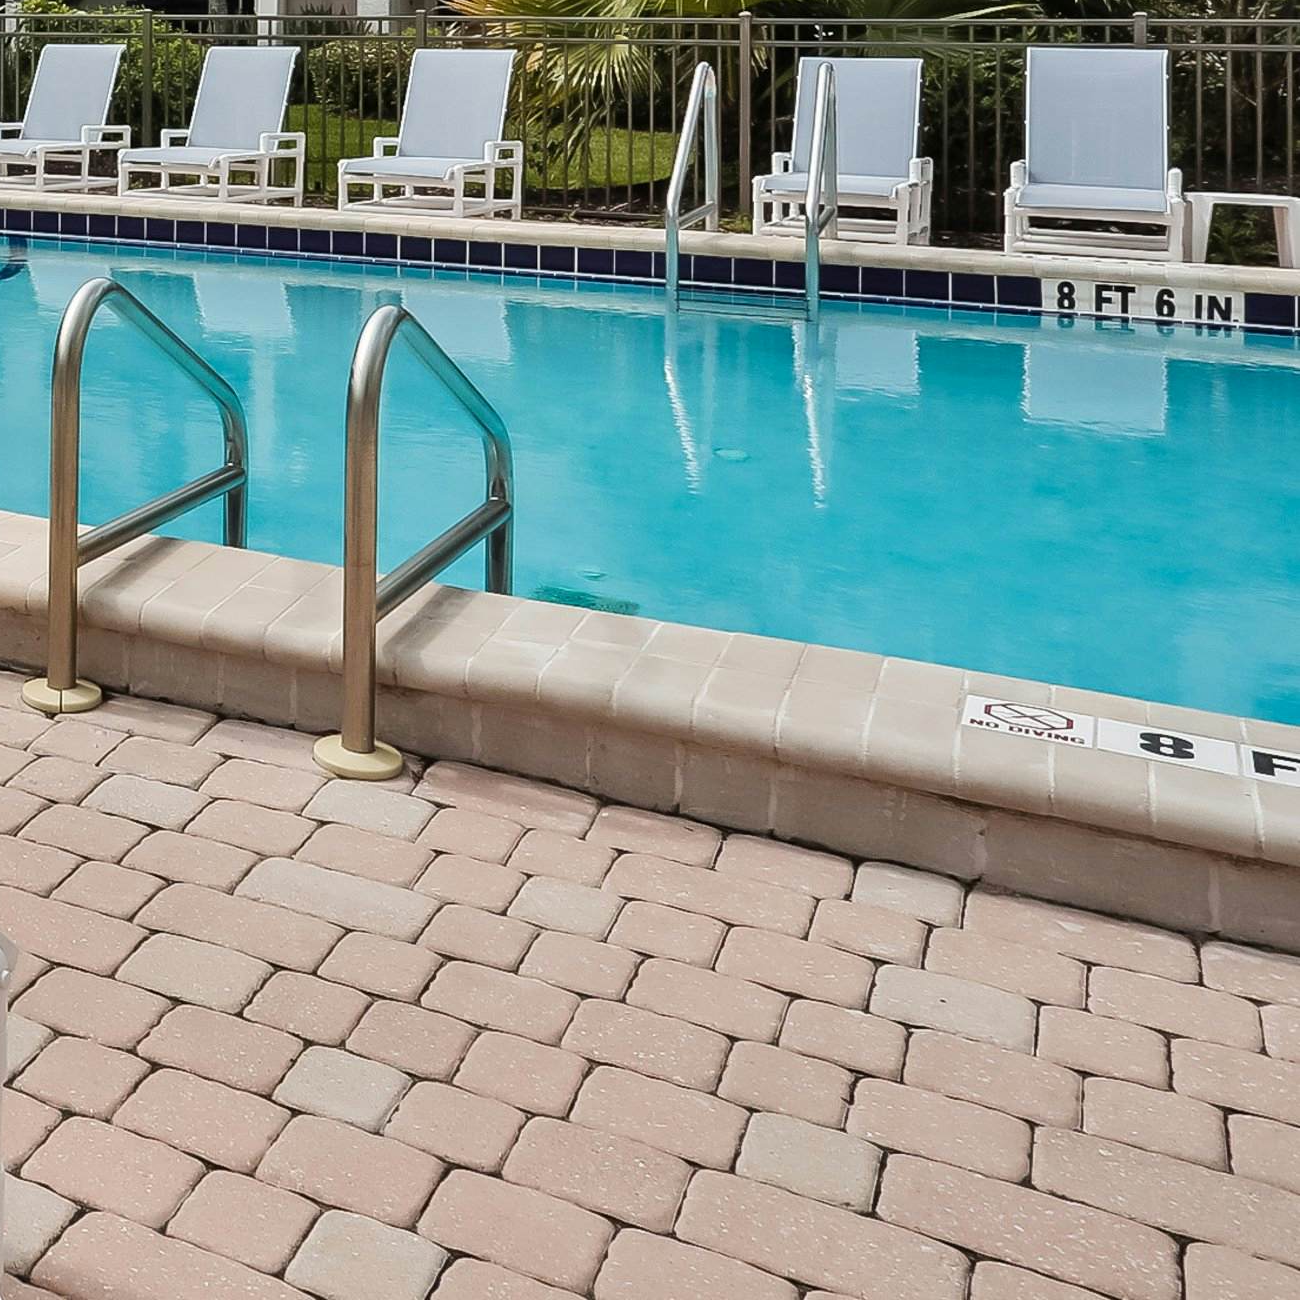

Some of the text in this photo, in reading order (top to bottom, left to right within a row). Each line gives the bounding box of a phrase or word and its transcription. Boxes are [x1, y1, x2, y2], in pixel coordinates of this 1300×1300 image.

[1057, 281, 1240, 322] 8 FT 6 IN.
[969, 718, 1085, 745] NO DIVING
[1138, 731, 1196, 760] 8
